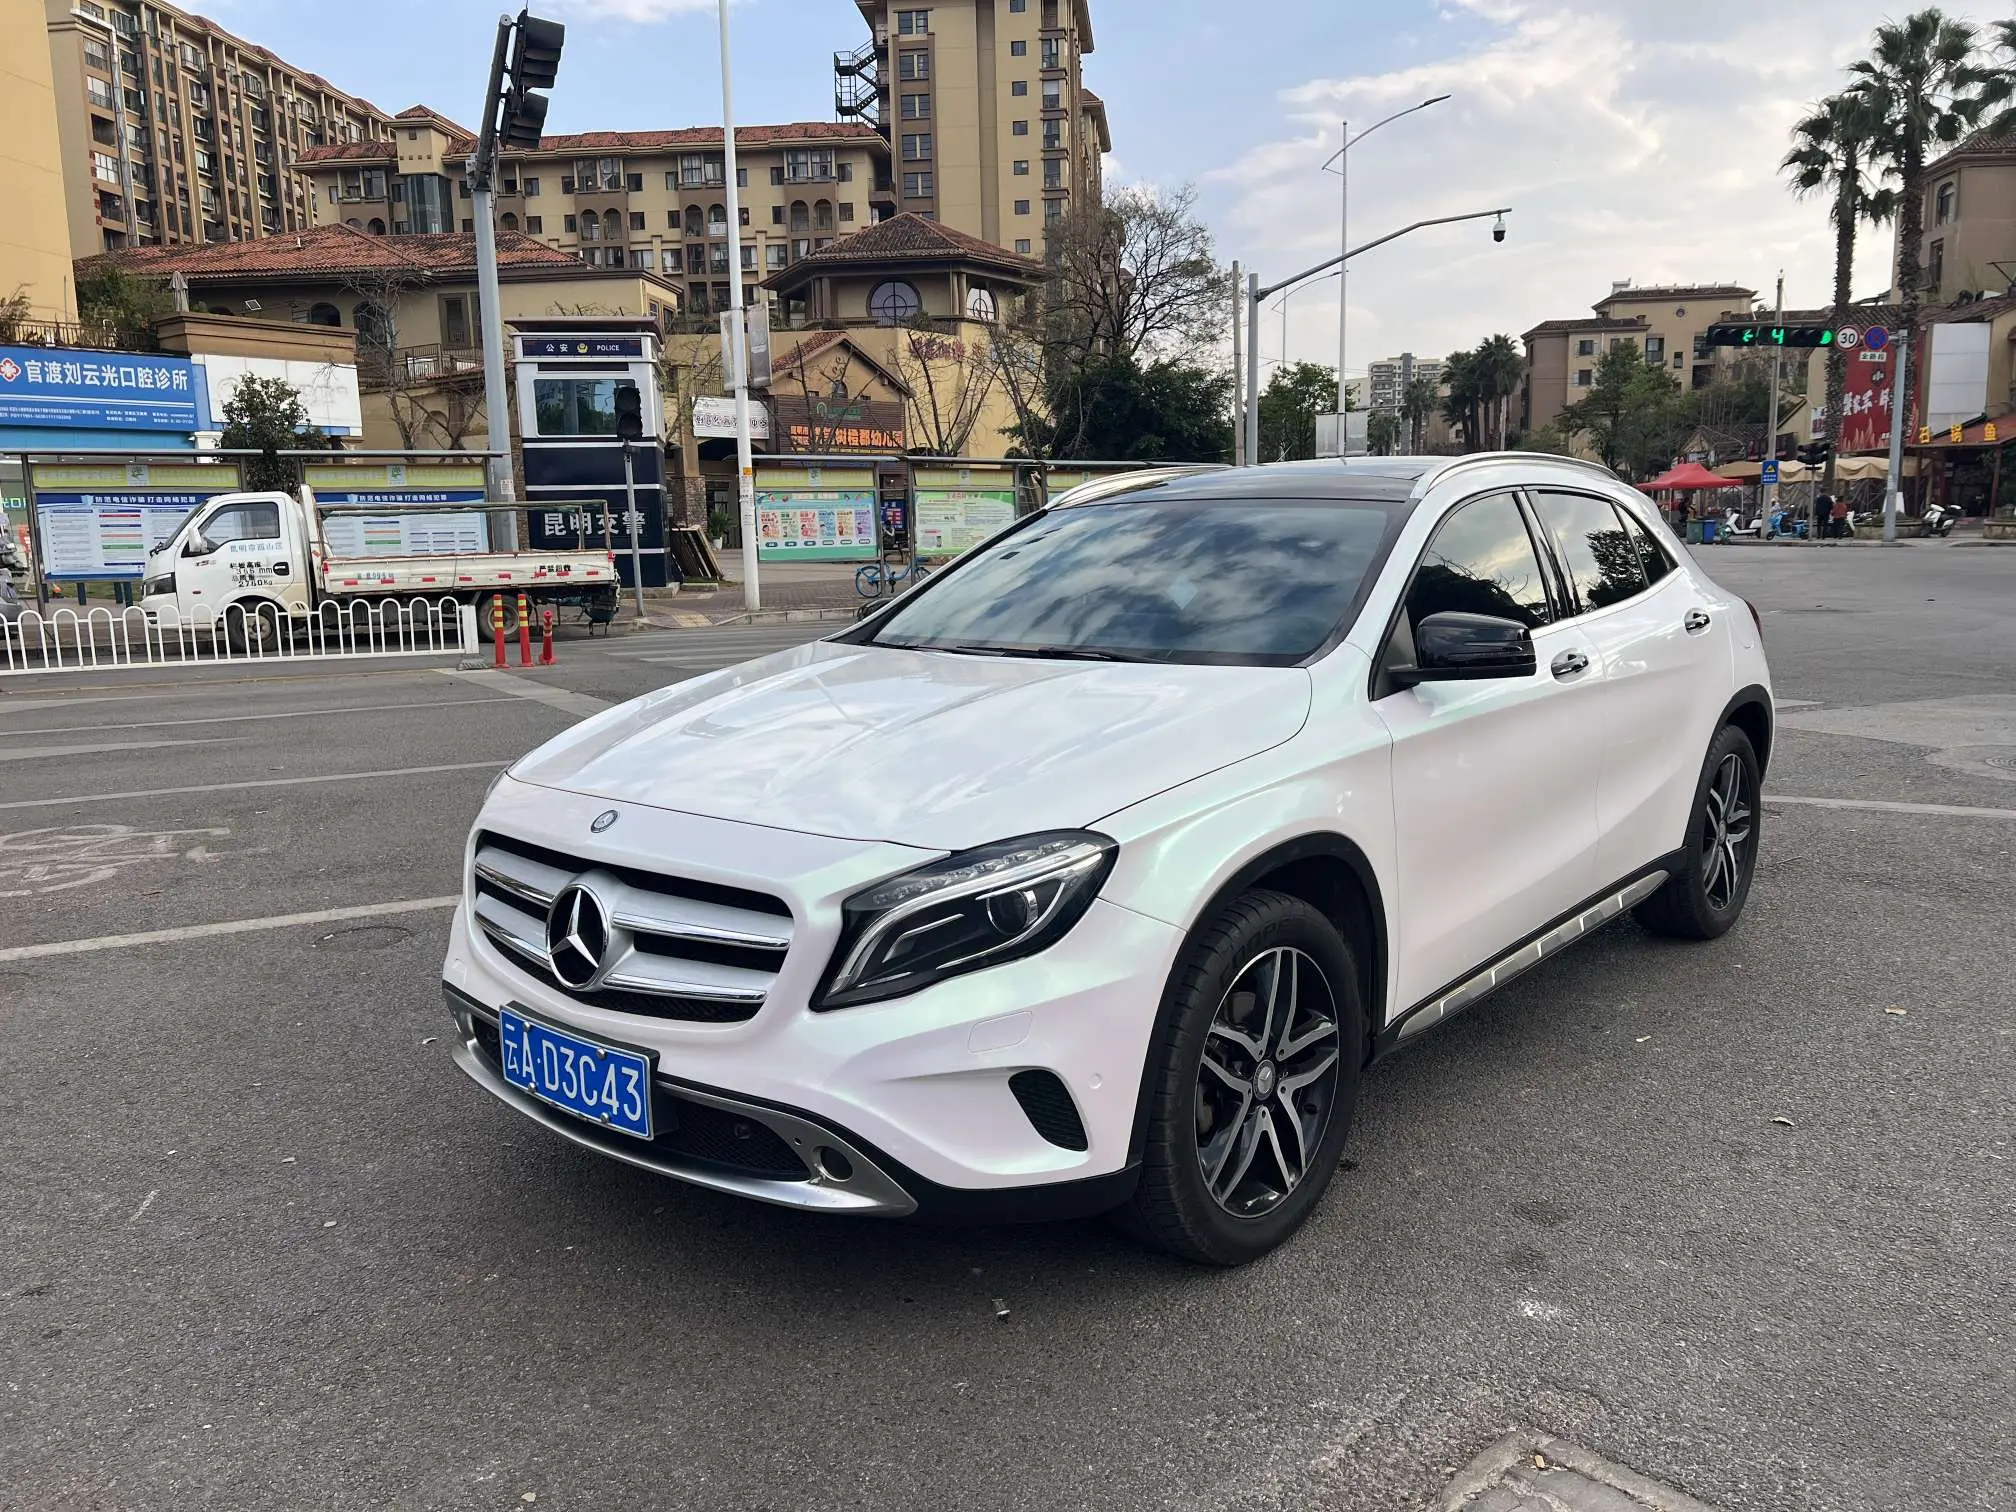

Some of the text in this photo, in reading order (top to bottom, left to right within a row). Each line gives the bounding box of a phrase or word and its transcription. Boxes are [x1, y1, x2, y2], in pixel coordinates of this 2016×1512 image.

[1840, 333, 1856, 344] 30
[545, 343, 620, 353] 公安 POLICE
[24, 359, 188, 391] 官渡刘云光口腔诊所
[544, 510, 646, 536] 昆明交警
